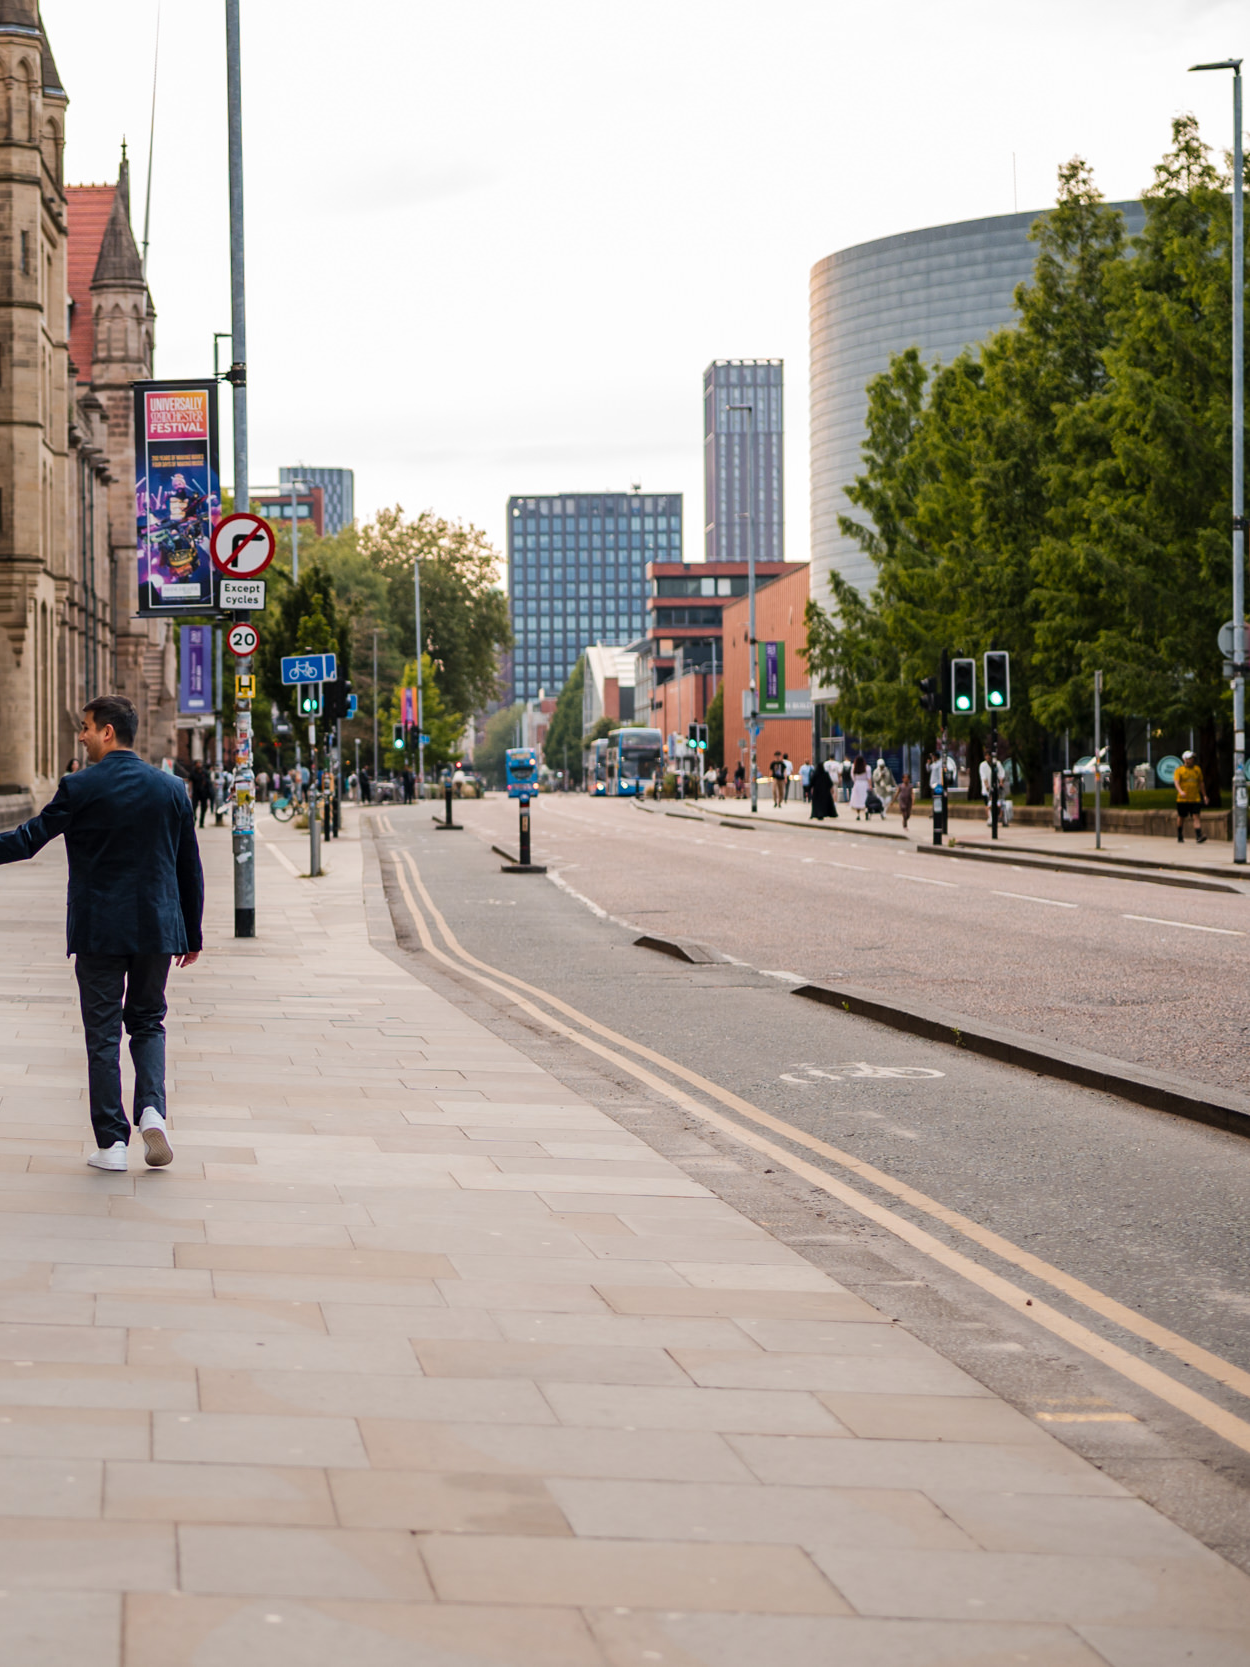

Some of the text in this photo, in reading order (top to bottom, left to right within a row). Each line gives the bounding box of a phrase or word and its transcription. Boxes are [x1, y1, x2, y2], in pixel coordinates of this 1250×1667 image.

[150, 397, 203, 411] UNIVERSALLY
[150, 423, 204, 433] FESTIVAL
[225, 584, 260, 594] Except
[226, 595, 259, 605] cycles
[233, 633, 255, 646] 20
